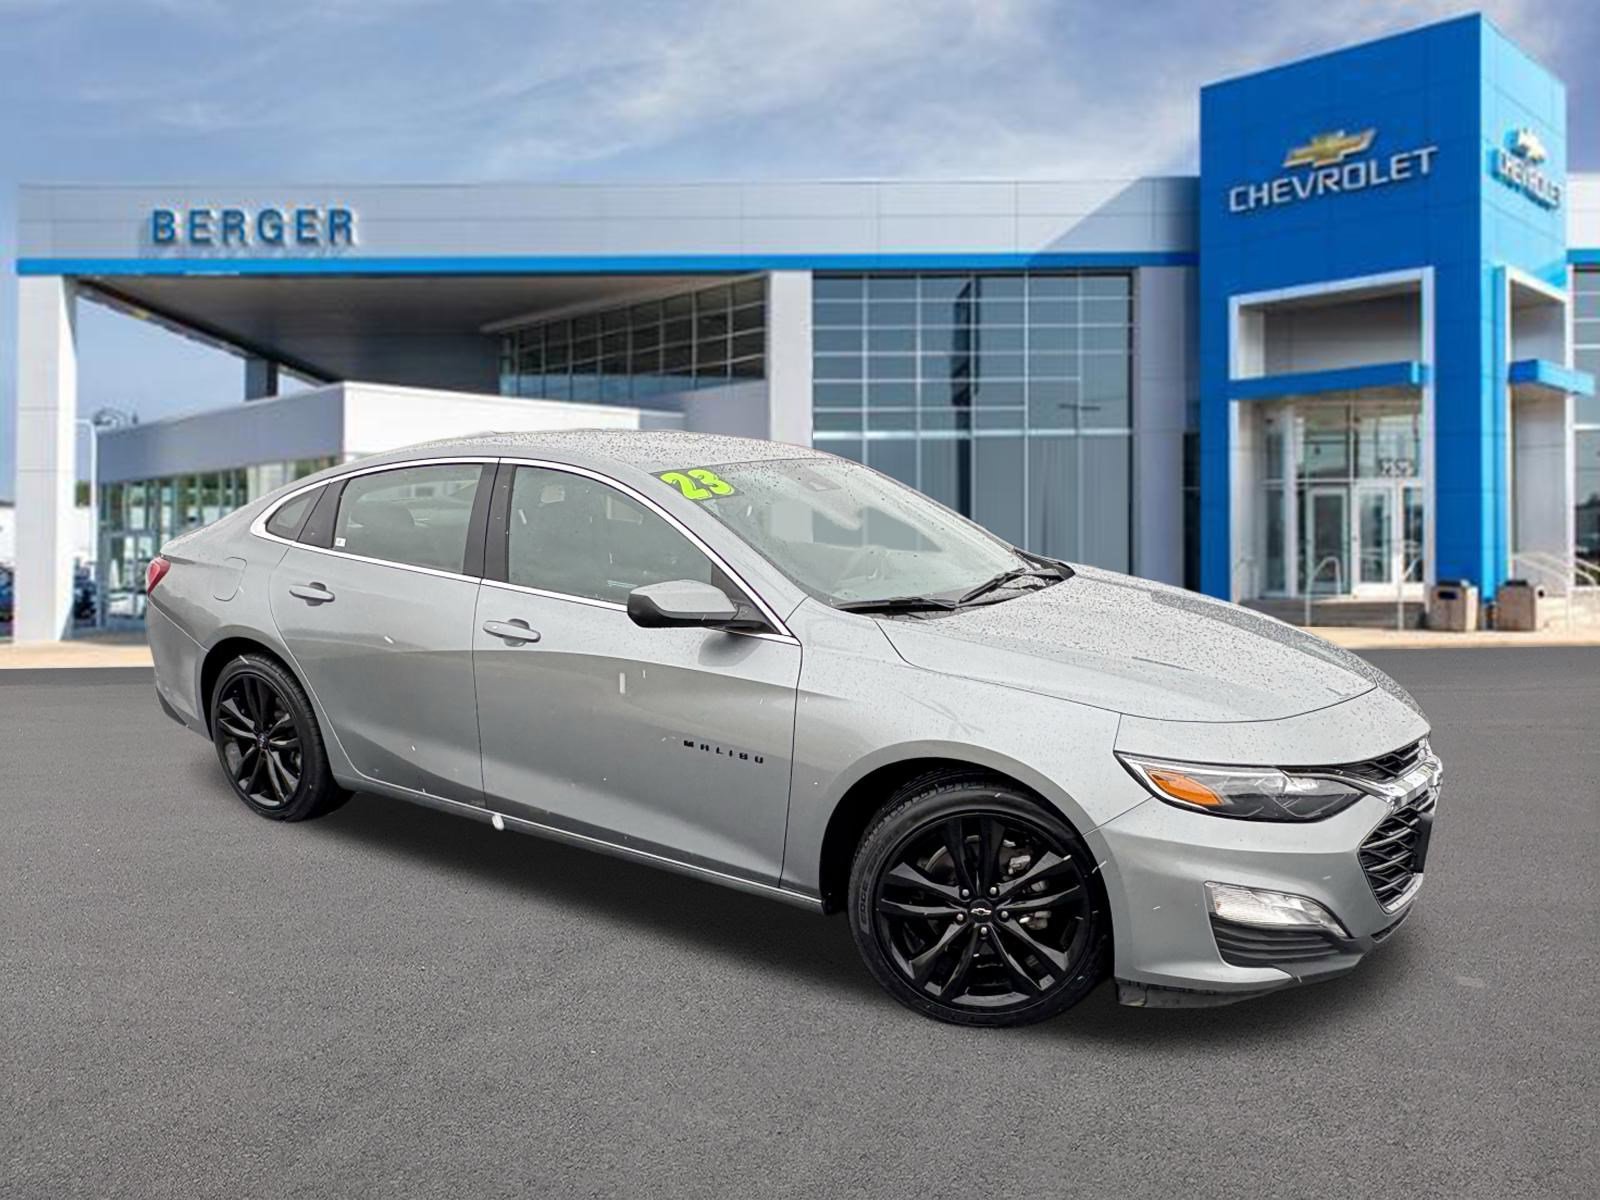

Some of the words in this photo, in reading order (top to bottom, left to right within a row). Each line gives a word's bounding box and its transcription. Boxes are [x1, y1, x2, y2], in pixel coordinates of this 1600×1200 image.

[1229, 146, 1438, 213] CHEVROLET
[152, 207, 356, 246] BERGER
[660, 469, 735, 500] 23
[683, 740, 764, 764] MALIBU
